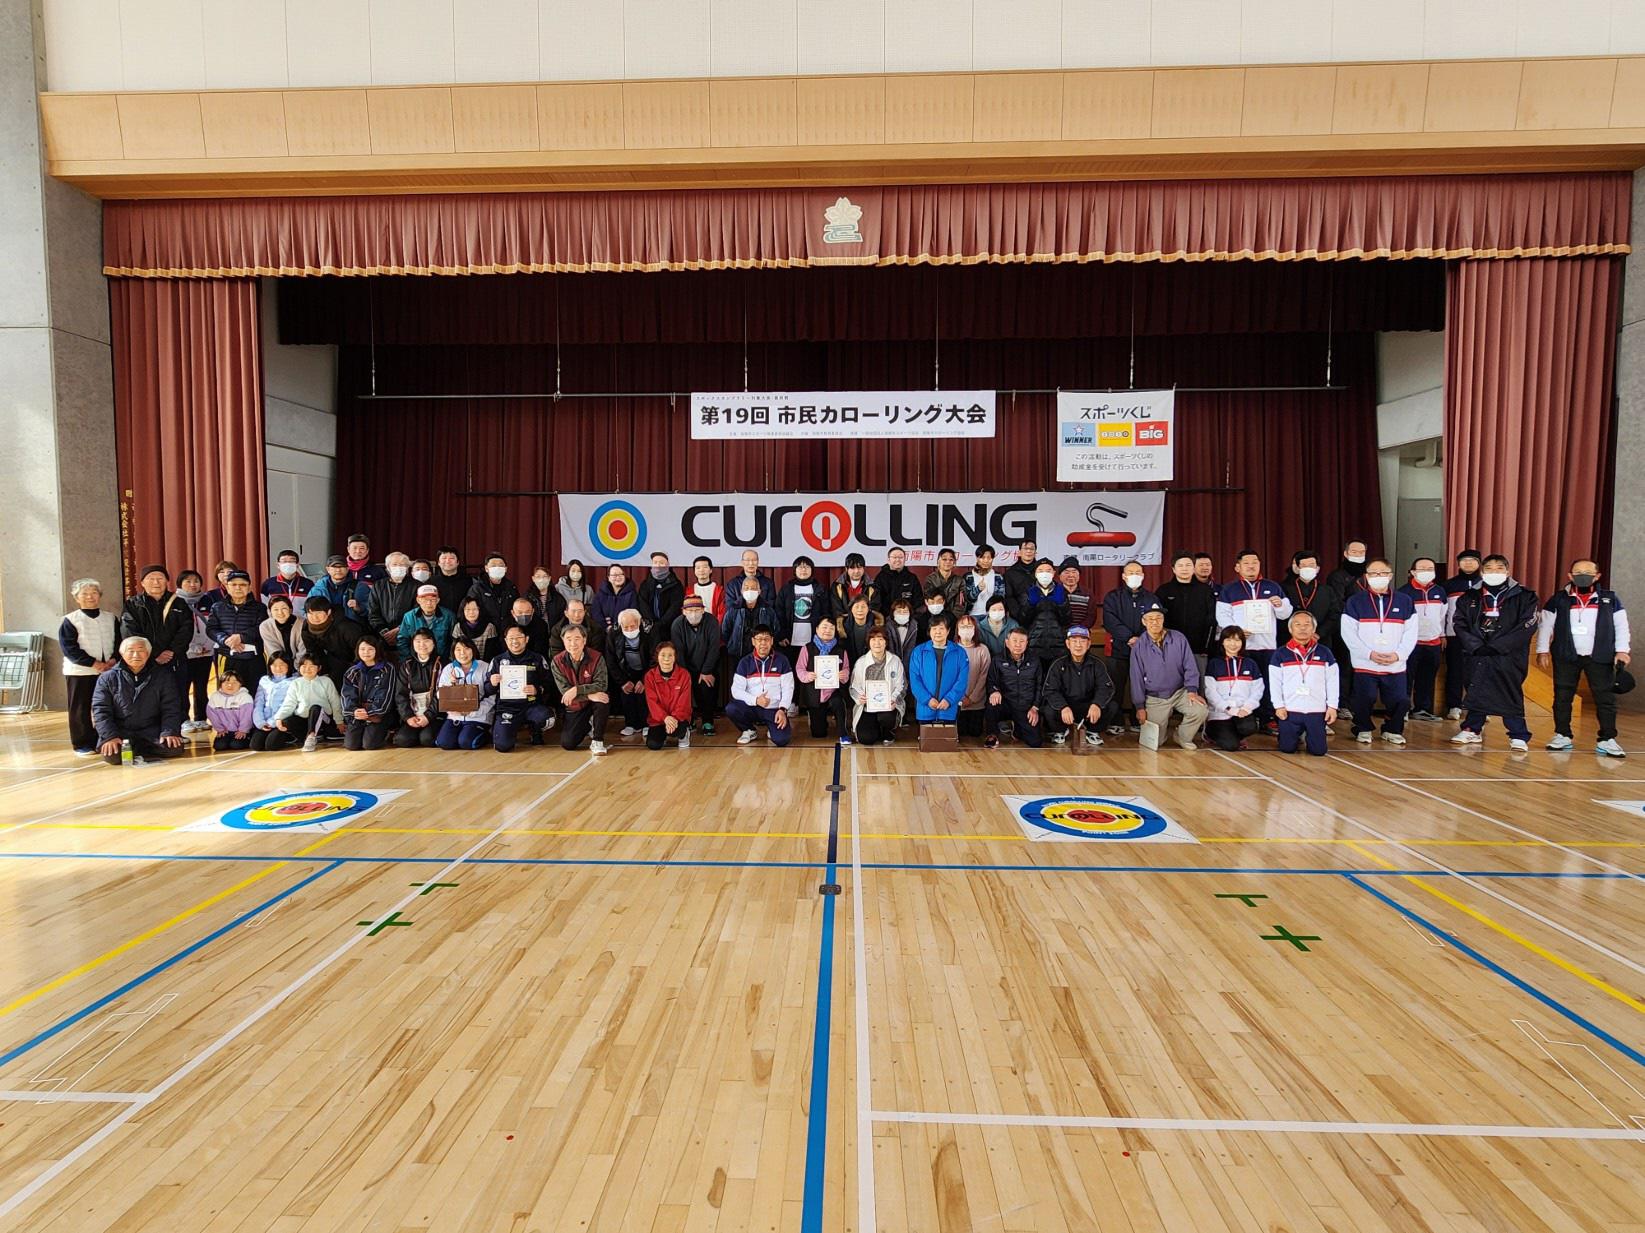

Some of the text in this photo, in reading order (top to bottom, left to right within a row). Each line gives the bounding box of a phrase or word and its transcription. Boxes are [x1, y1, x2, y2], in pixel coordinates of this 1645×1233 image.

[700, 403, 987, 426] 第19回 市民カローリング大会
[1080, 404, 1152, 420] スポーツくじ
[1064, 436, 1092, 444] WINNER
